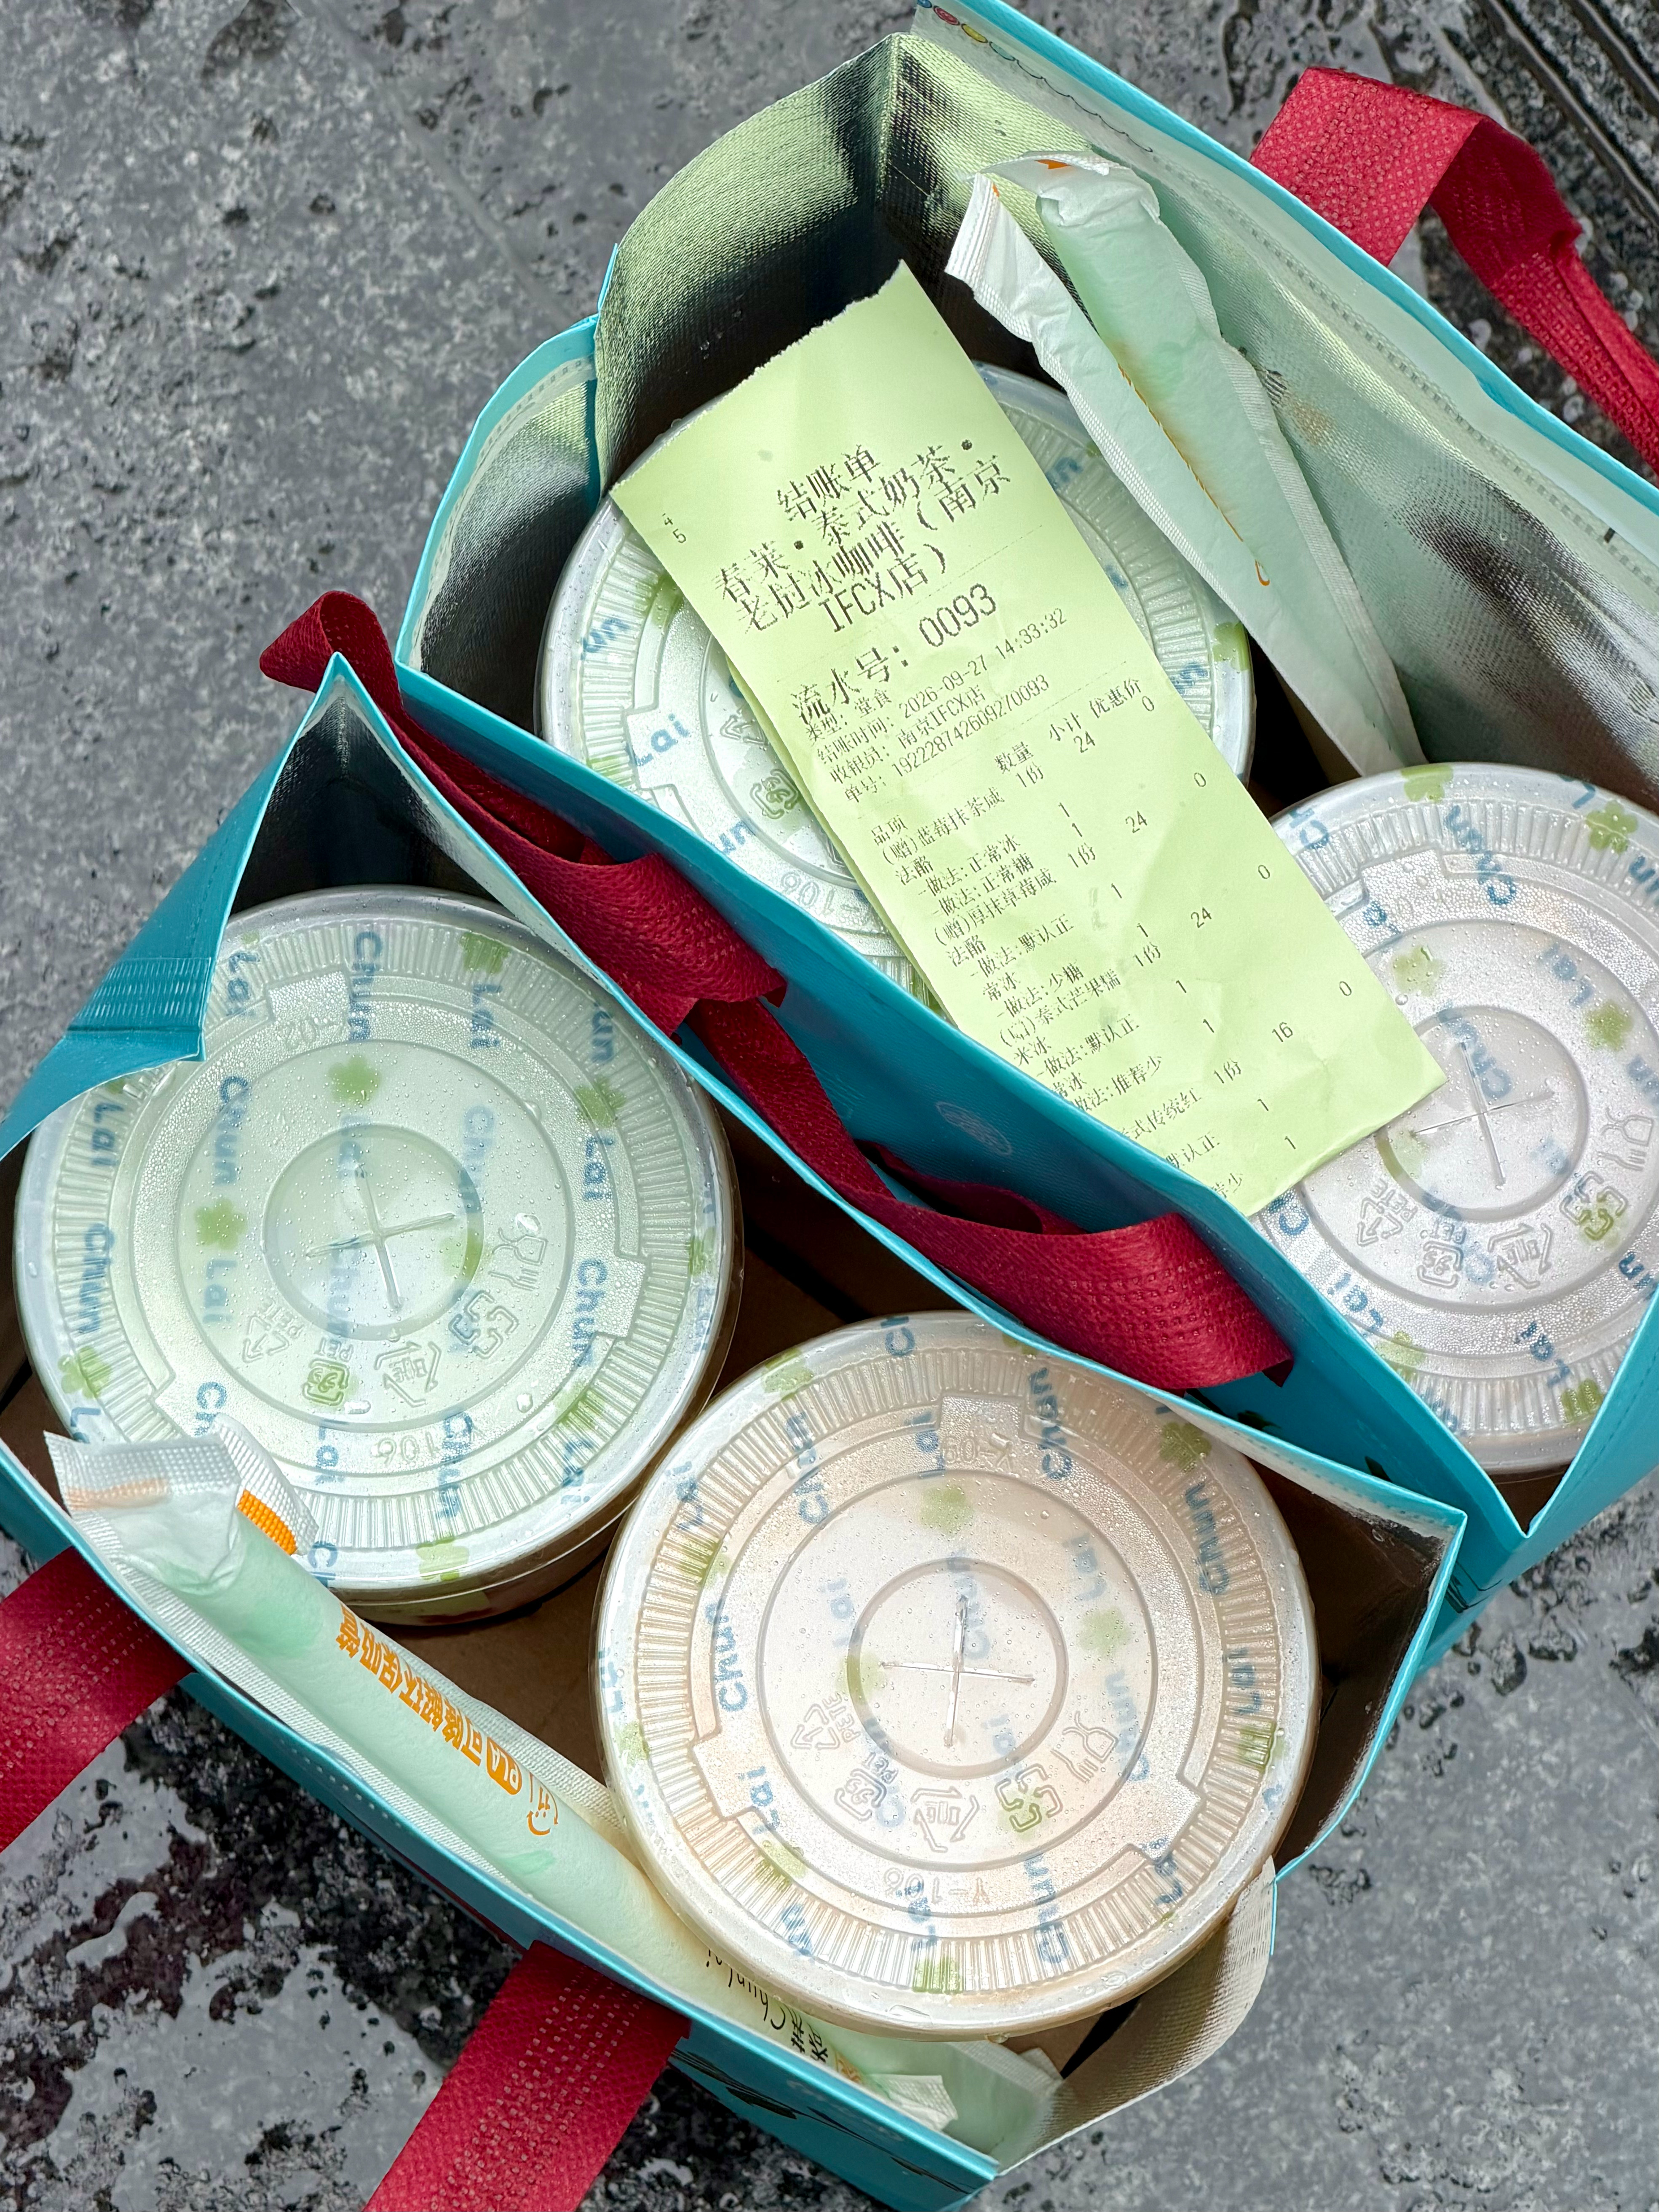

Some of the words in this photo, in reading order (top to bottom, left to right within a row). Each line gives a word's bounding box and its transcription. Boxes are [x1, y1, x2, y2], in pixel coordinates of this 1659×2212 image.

[918, 583, 997, 648] 0093
[626, 713, 690, 767] Lai
[891, 674, 1049, 777] 192228742609270093
[1073, 731, 1096, 754] 24
[1142, 695, 1155, 712] 0
[1058, 802, 1070, 818] 1
[1071, 822, 1083, 838] 1
[1125, 810, 1148, 834] 24
[1193, 772, 1207, 788] 0
[1111, 883, 1123, 899] 1
[1190, 907, 1212, 929] 24
[1258, 864, 1271, 880] 0
[1136, 923, 1149, 938] 1
[1175, 979, 1187, 994] 1
[1271, 1021, 1293, 1043] 16
[1339, 981, 1352, 997] 0
[1202, 1019, 1215, 1033] 1
[92, 1101, 125, 1167] Lai
[1257, 1098, 1269, 1112] 1
[1284, 1136, 1296, 1150] 1
[203, 1260, 237, 1324] Lai
[573, 1259, 607, 1366] Chun
[1185, 1482, 1230, 1594] Chun
[738, 1765, 780, 1836] Lai
